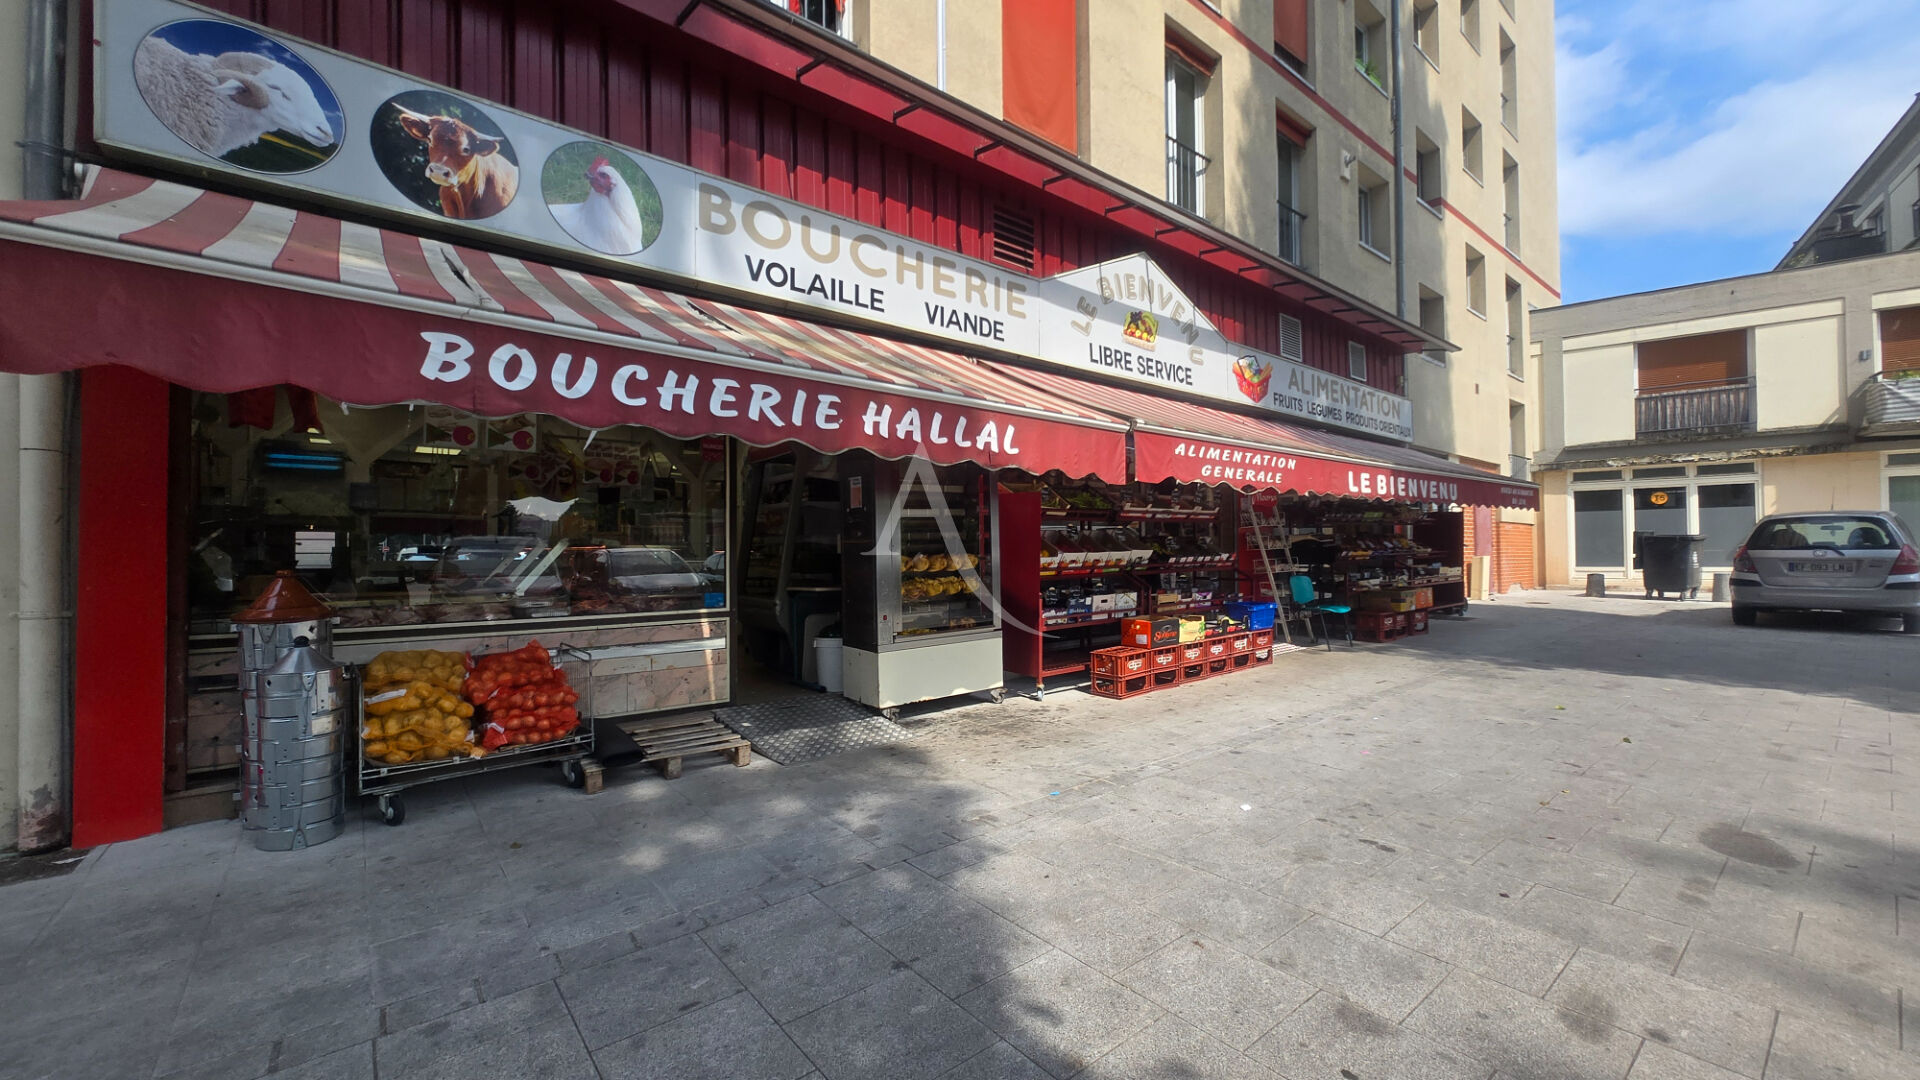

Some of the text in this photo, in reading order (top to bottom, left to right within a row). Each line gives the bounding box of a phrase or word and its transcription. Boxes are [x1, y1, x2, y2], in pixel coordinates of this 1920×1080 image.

[698, 182, 1028, 320] BOUCHERIE
[744, 254, 1006, 342] VOLAILLE VIANDE
[1070, 296, 1098, 337] LE
[1089, 342, 1193, 386] LIBRE SERVICE
[420, 331, 1020, 455] BOUCHERIE HALLAL
[1273, 392, 1412, 437] FRUITS LEGUMES PRODUITS ORIENTAUX
[1288, 367, 1401, 420] ALIMENTATION
[1174, 442, 1297, 470] ALIMENTATION
[1201, 464, 1283, 484] GENERALE
[1348, 470, 1459, 500] LE BIENVENU
